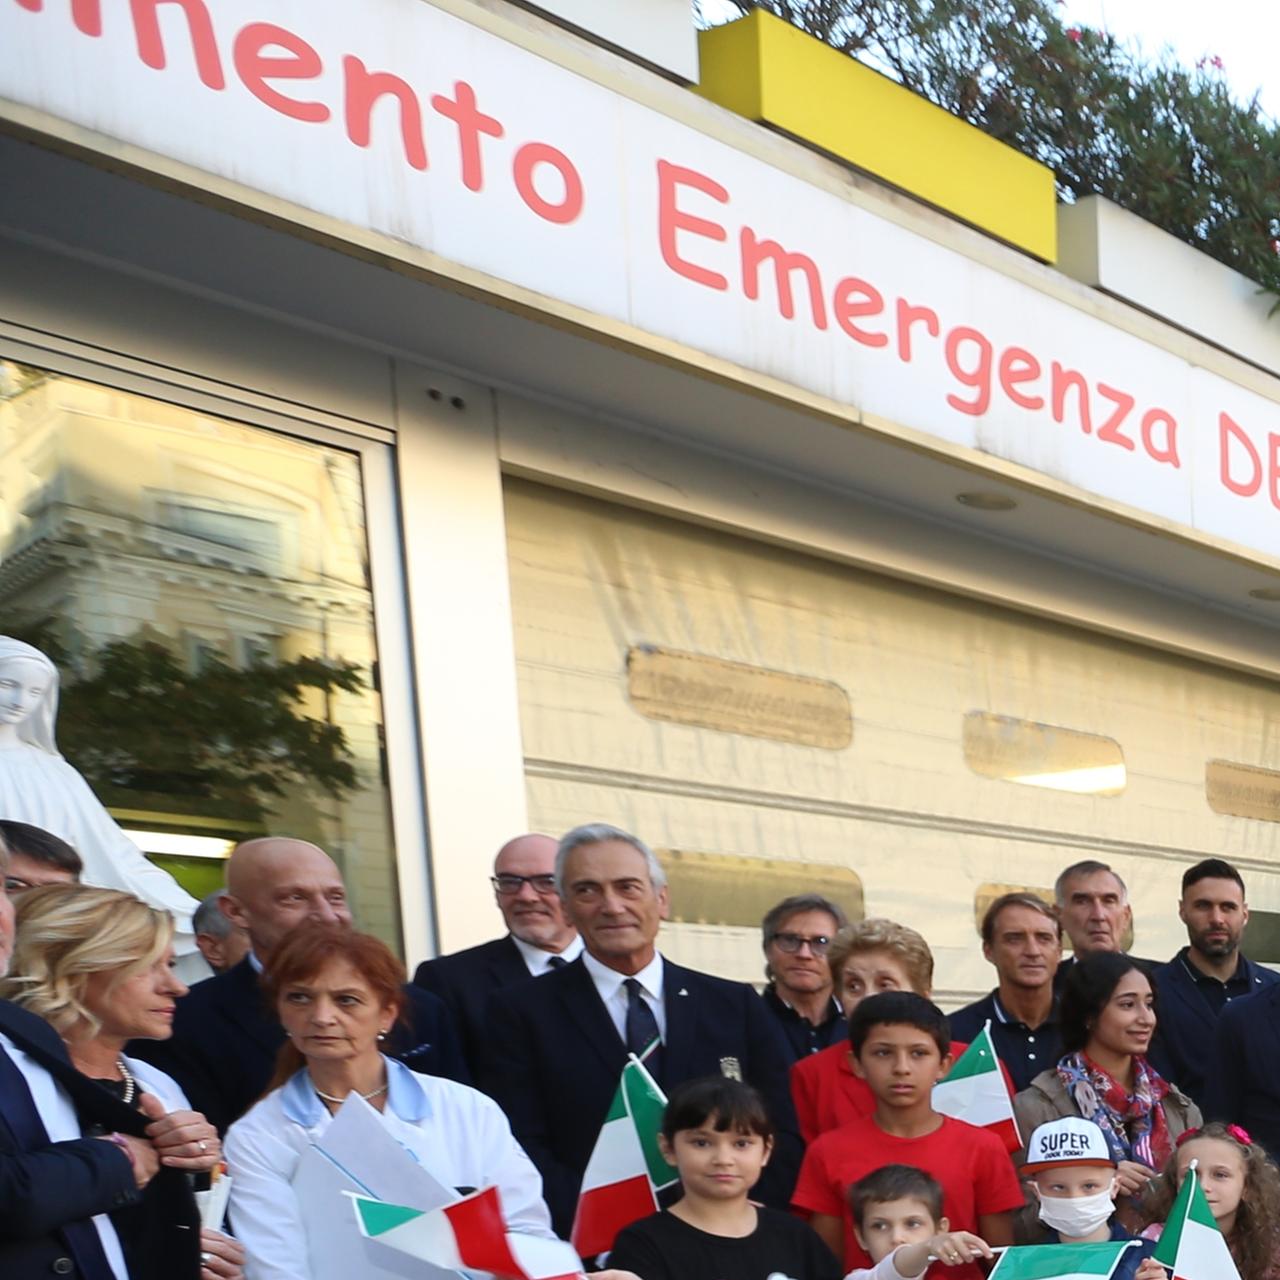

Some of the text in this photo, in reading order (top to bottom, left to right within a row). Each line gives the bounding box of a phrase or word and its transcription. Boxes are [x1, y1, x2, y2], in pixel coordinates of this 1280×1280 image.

[14, 0, 585, 224] mento
[656, 158, 1181, 468] Emergenza
[1040, 1132, 1091, 1154] SUPER
